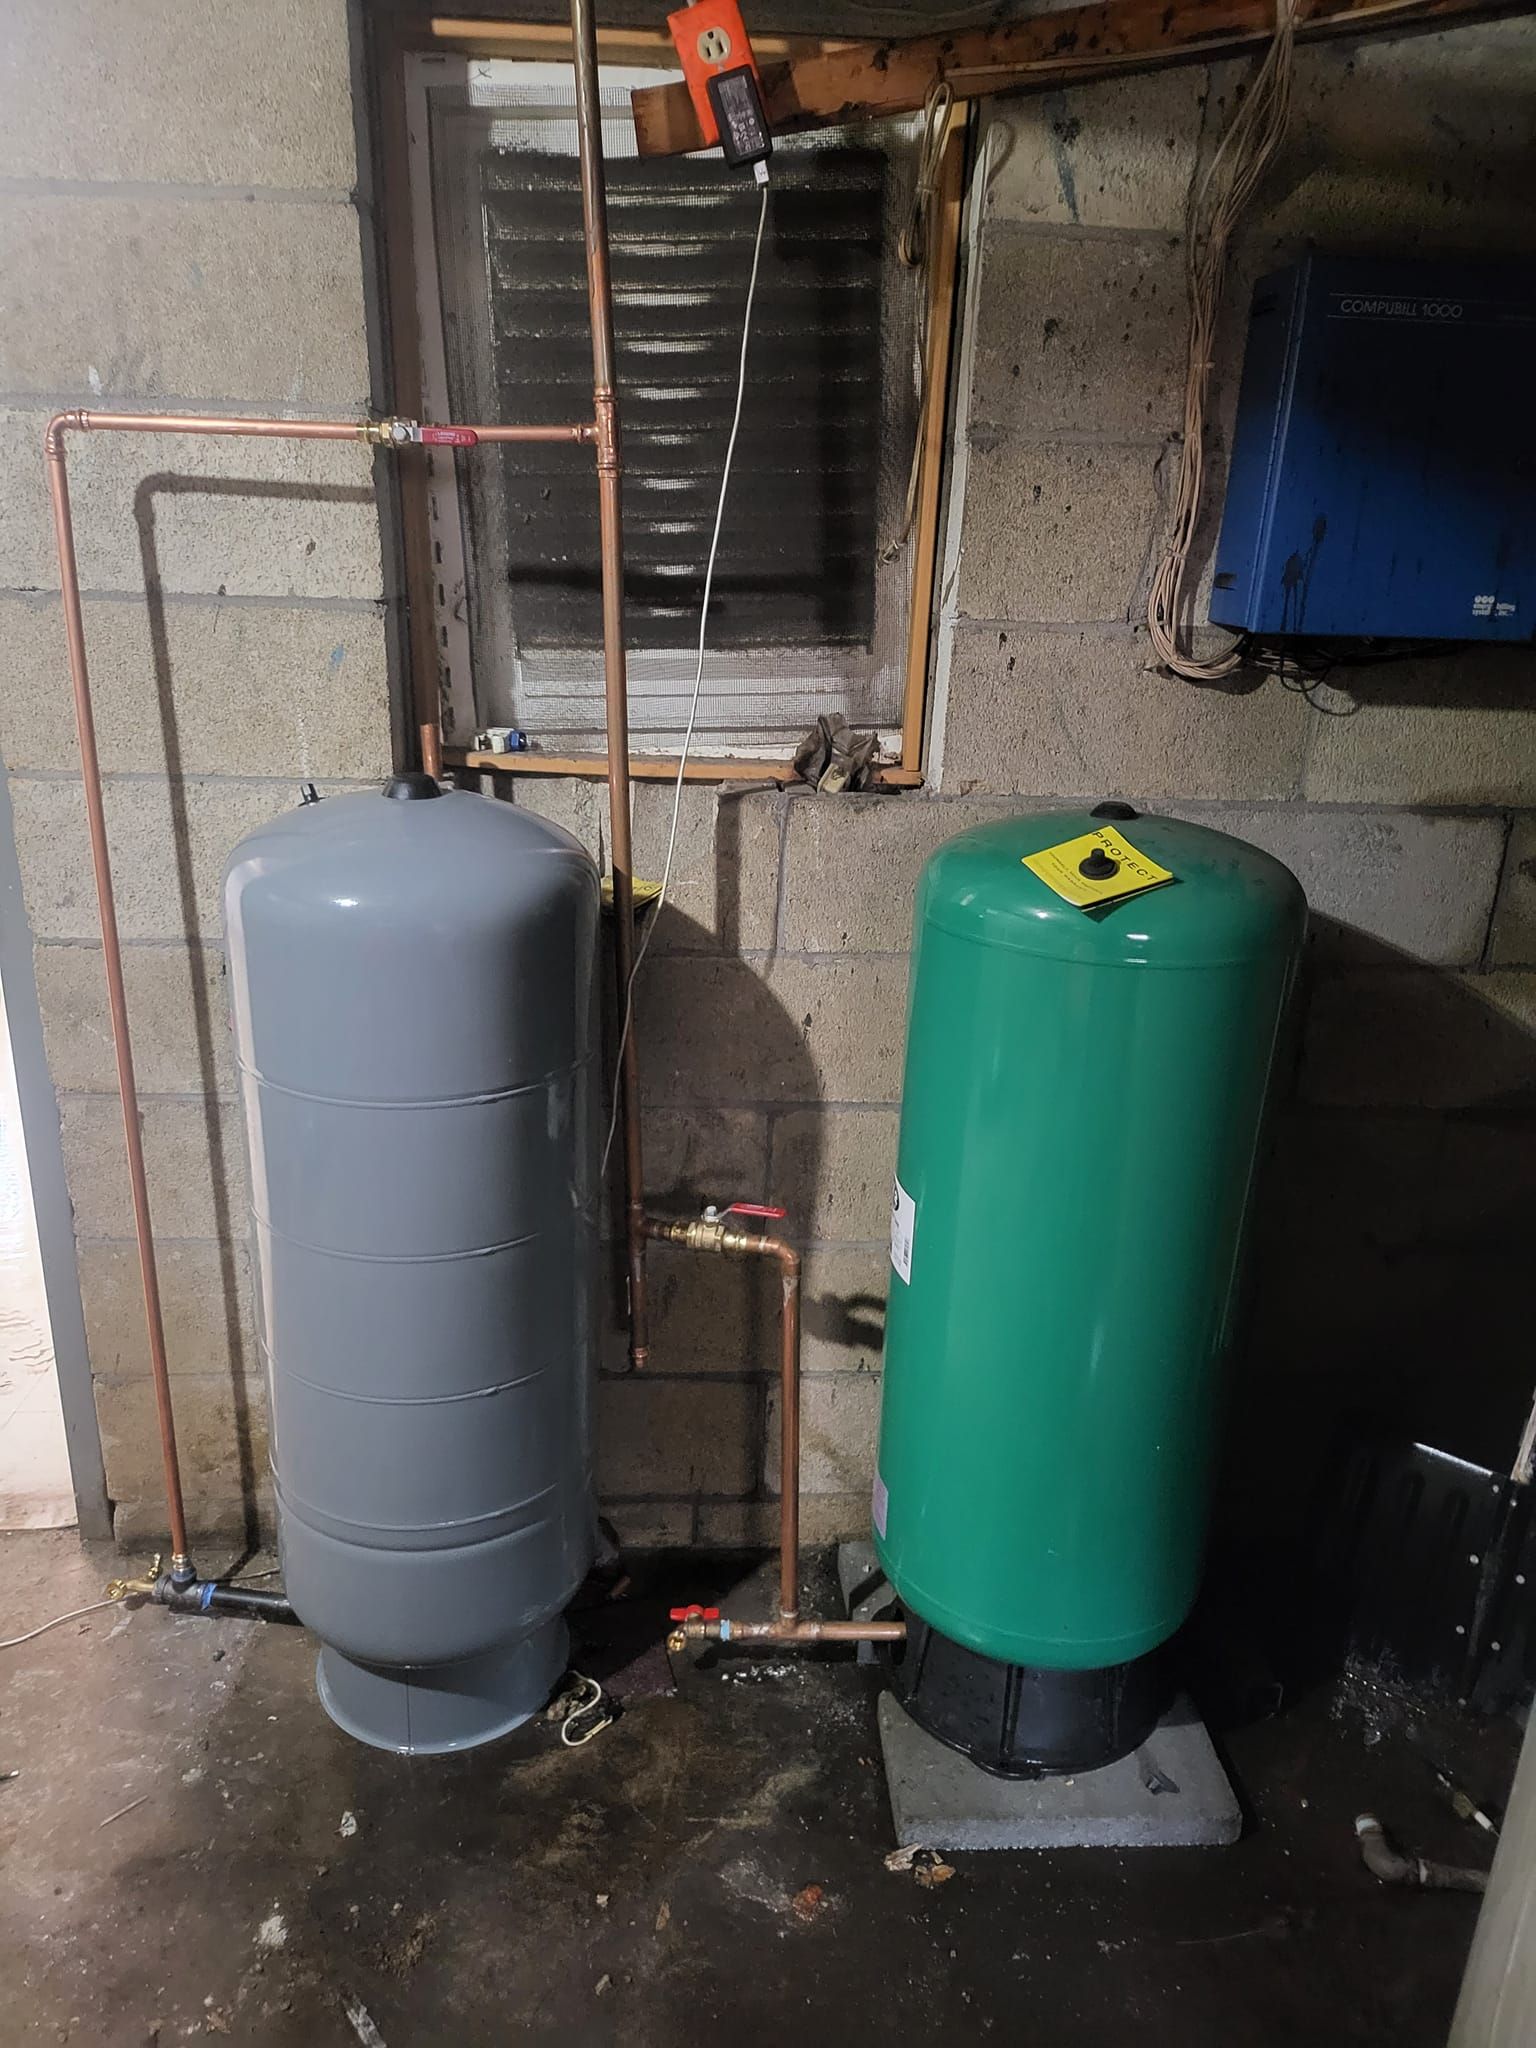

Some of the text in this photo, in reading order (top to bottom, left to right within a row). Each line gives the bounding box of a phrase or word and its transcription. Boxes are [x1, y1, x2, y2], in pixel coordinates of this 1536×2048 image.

[1341, 299, 1463, 318] COMPUBILL 1000
[1092, 831, 1158, 881] PROTECT
